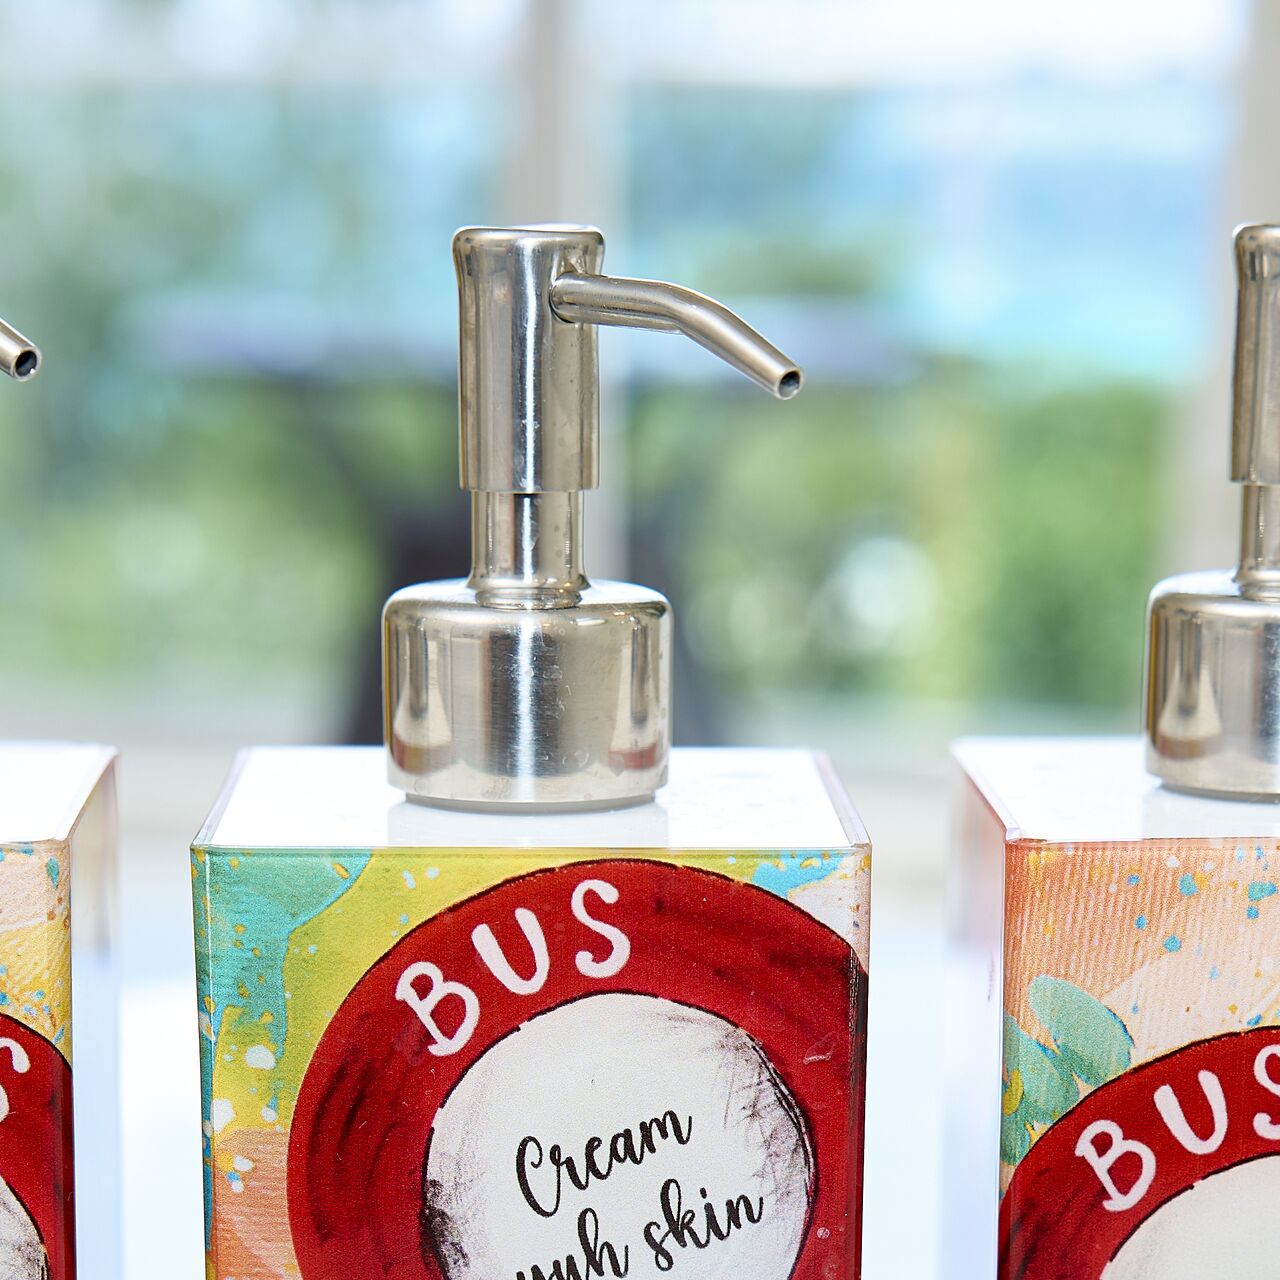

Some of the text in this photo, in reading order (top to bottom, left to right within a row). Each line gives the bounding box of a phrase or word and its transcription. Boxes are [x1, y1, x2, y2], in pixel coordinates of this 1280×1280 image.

[396, 880, 631, 1056] BUS
[516, 1110, 693, 1217] Cream
[643, 1178, 765, 1273] skin
